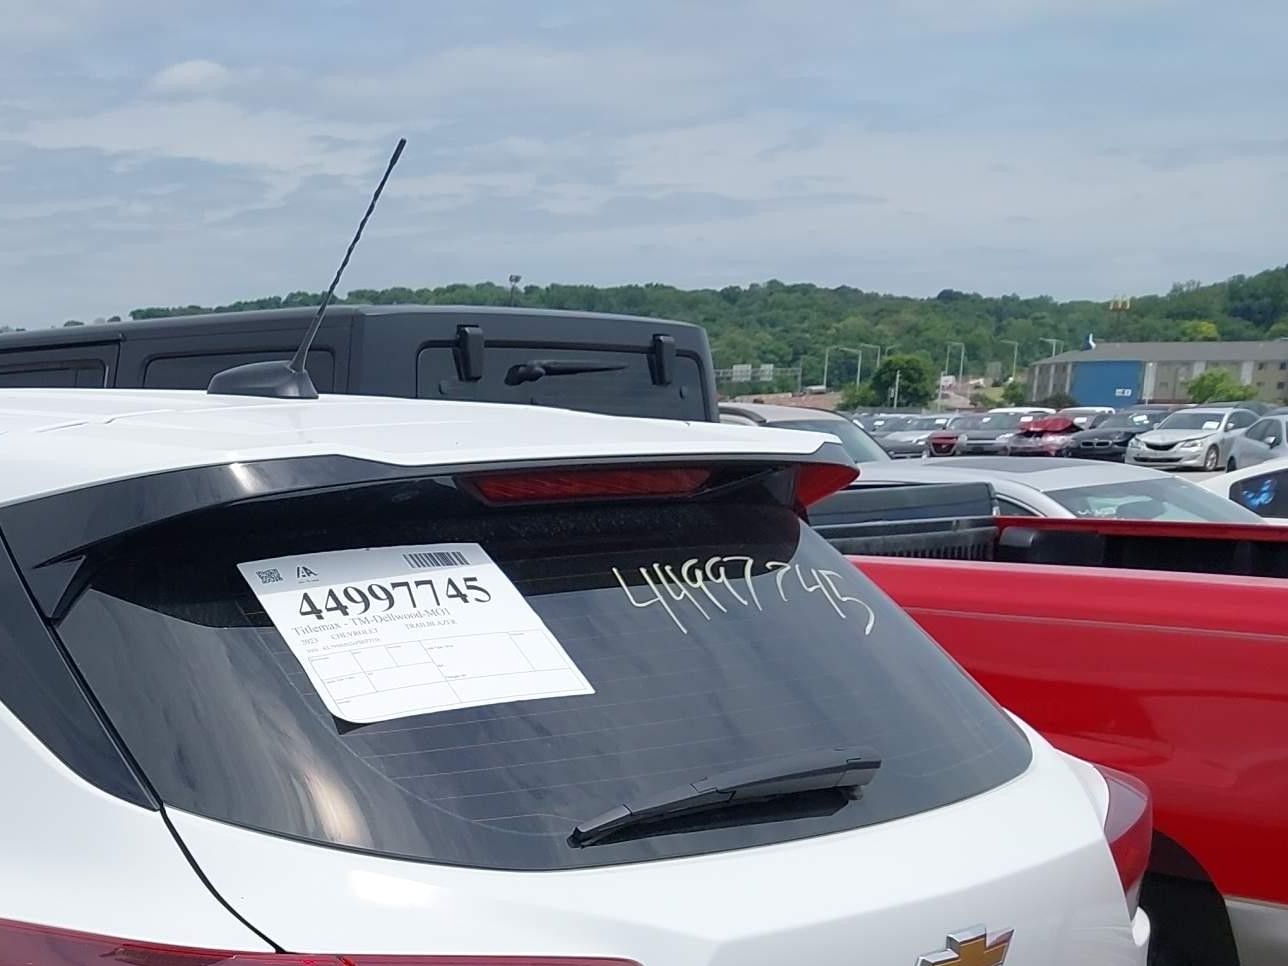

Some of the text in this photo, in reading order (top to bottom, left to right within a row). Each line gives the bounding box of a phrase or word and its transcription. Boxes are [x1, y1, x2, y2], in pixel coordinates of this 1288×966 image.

[299, 576, 491, 620] 44997745
[612, 553, 875, 636] 44997745
[291, 622, 342, 636] Titlemax
